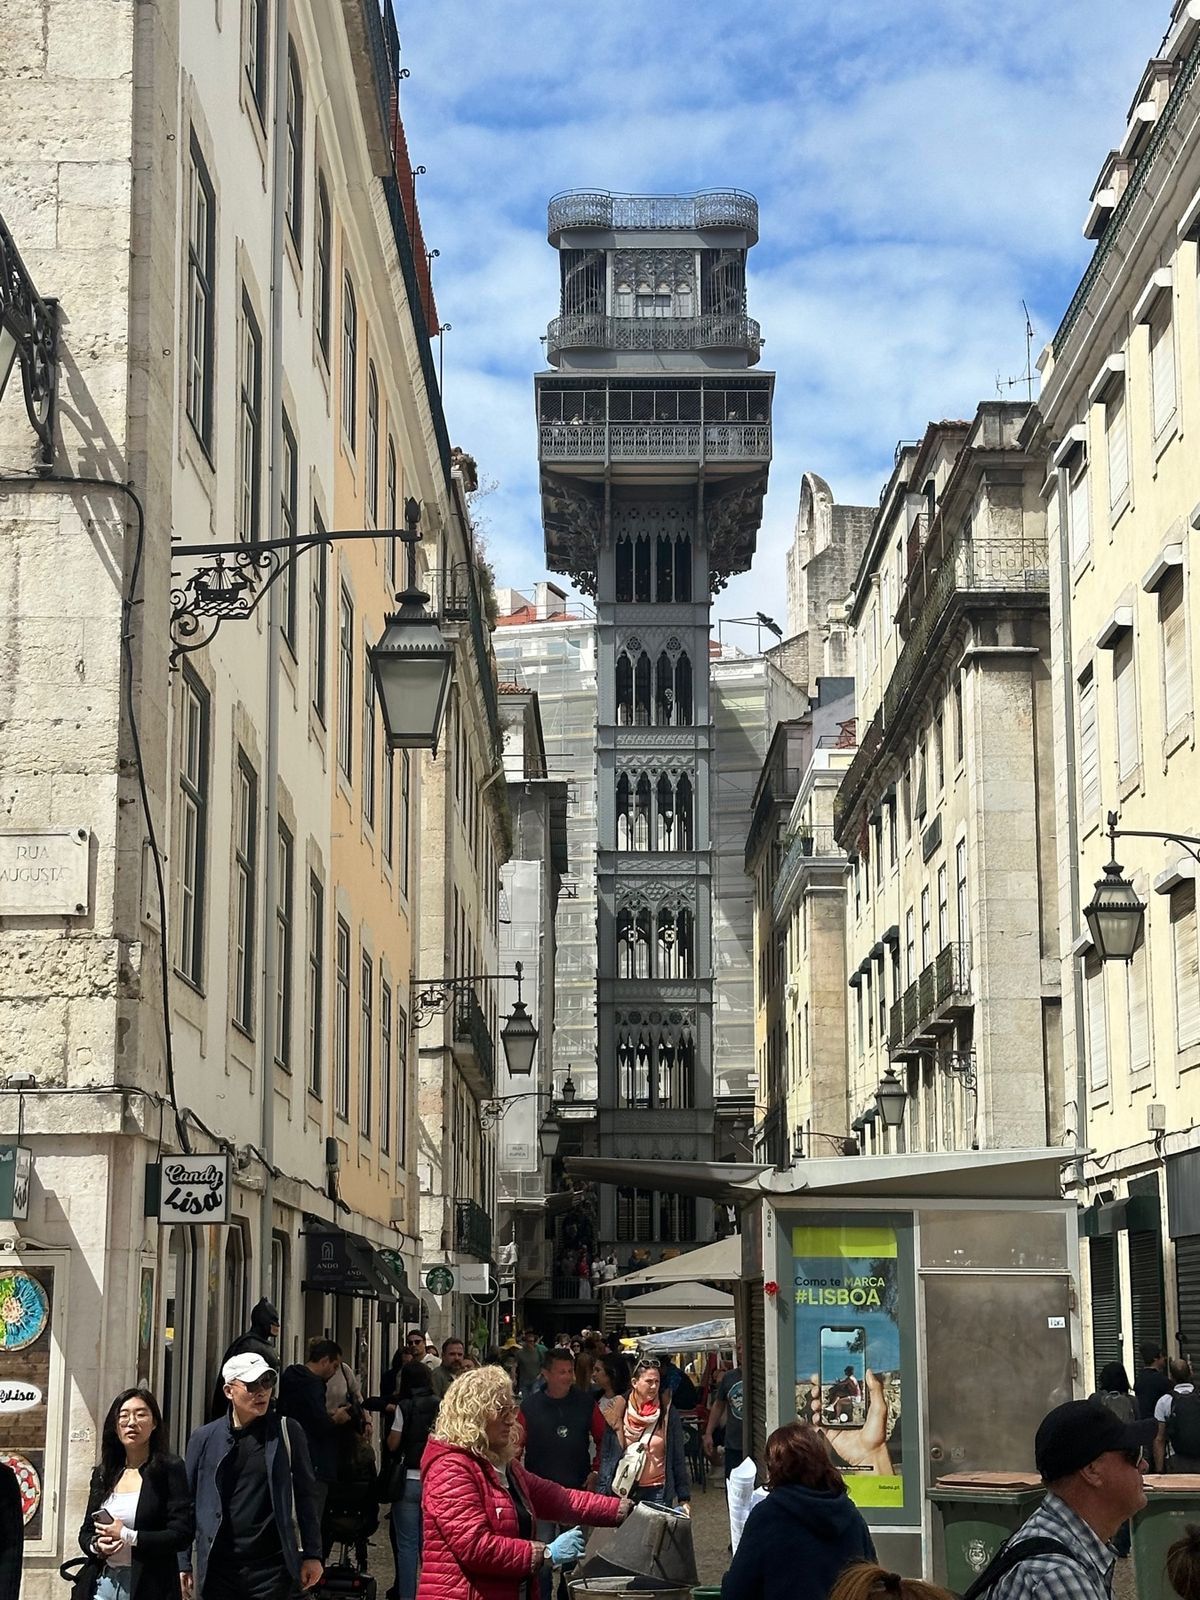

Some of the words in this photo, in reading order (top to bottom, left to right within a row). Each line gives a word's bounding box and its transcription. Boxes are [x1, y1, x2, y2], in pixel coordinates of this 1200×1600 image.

[17, 846, 49, 860] RUA
[0, 867, 67, 882] AUGUSTA
[165, 1164, 223, 1191] Candy
[164, 1187, 223, 1214] Lisa
[795, 1276, 827, 1286] Como
[830, 1277, 841, 1286] te
[844, 1276, 886, 1287] MARCA
[794, 1288, 881, 1305] #LISBOA
